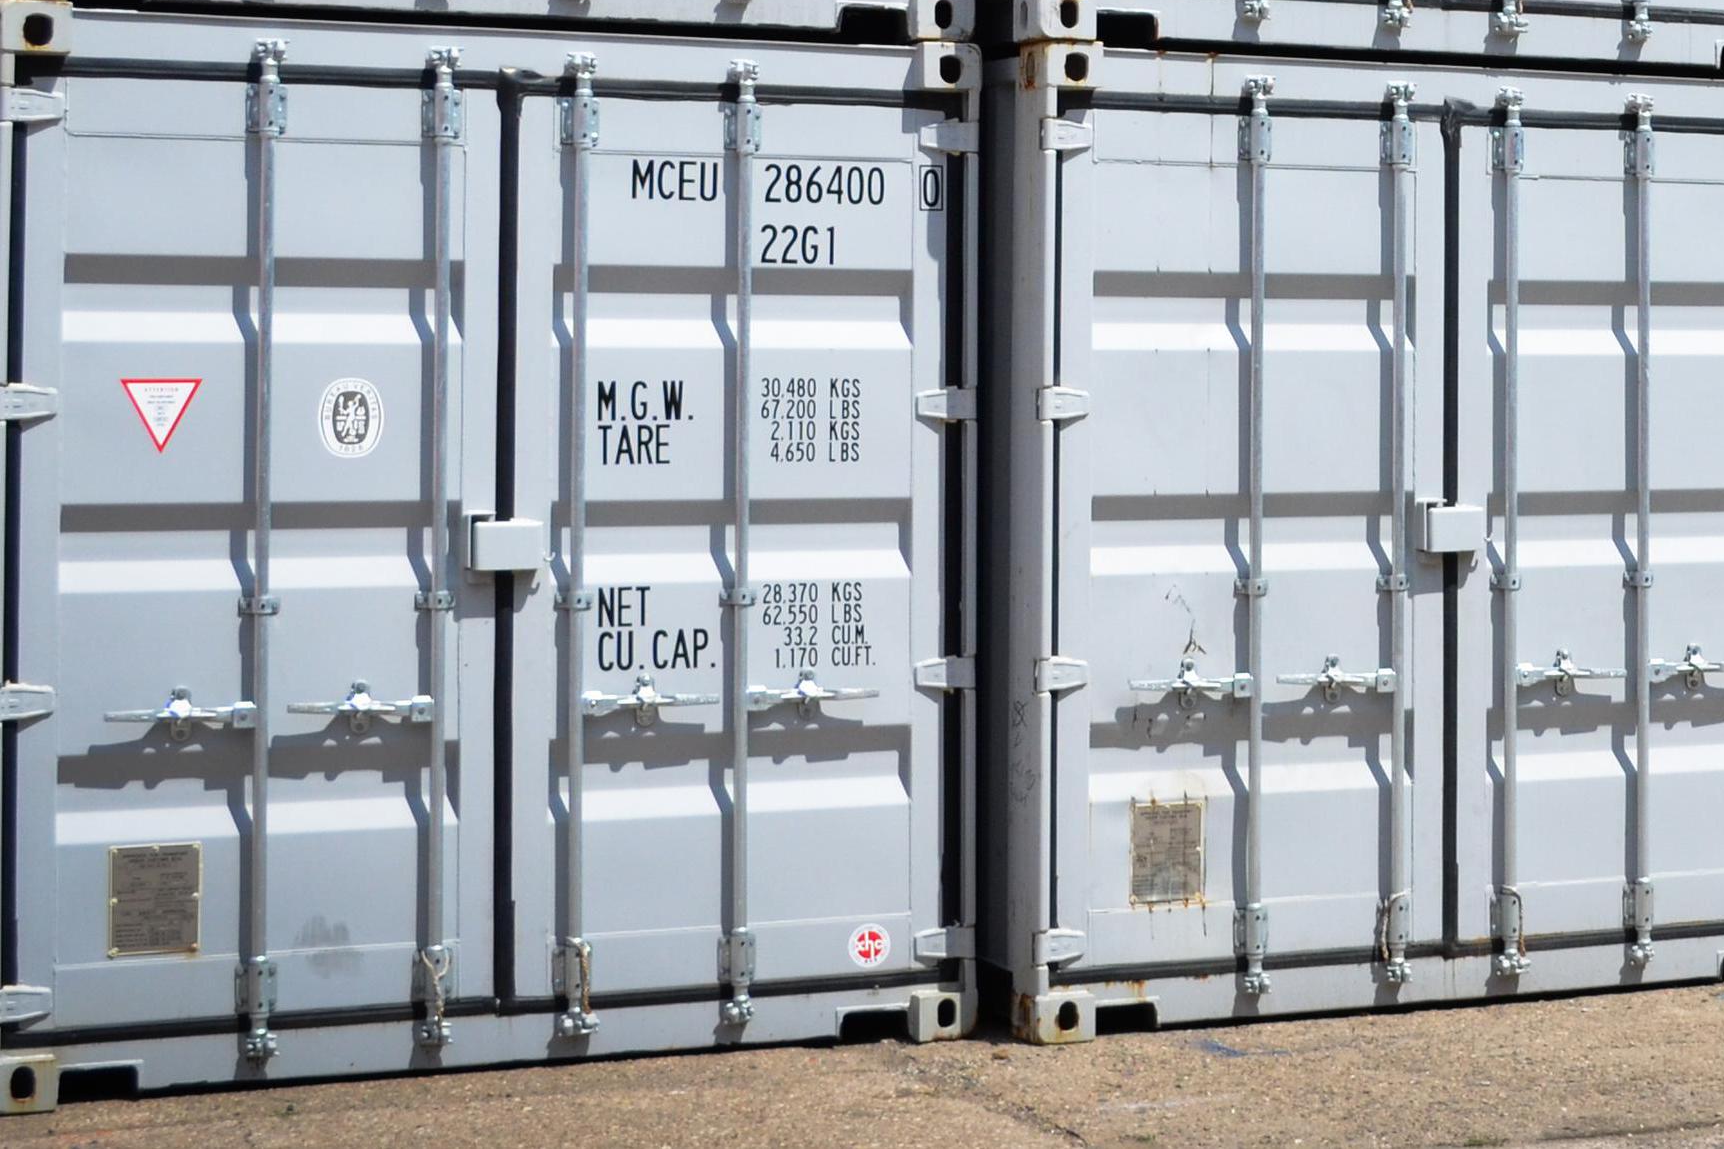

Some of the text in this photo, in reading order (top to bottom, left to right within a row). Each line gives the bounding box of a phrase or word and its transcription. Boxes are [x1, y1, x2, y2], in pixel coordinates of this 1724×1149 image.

[632, 160, 940, 207] MCEU 286400 0
[761, 224, 835, 265] 22G1
[762, 378, 860, 398] 30.480 KGS
[598, 381, 693, 421] M.G.W.
[761, 399, 860, 419] 67.200 LBS
[771, 421, 860, 441] 2.110 KGS
[598, 424, 670, 465] TARE
[771, 442, 859, 462] 4.650 LBS
[763, 582, 862, 604] 28.370 KGS
[598, 586, 650, 627] NET
[763, 603, 862, 625] 62.550 LBS
[784, 626, 817, 646] 33.2
[776, 647, 818, 668] 1.170
